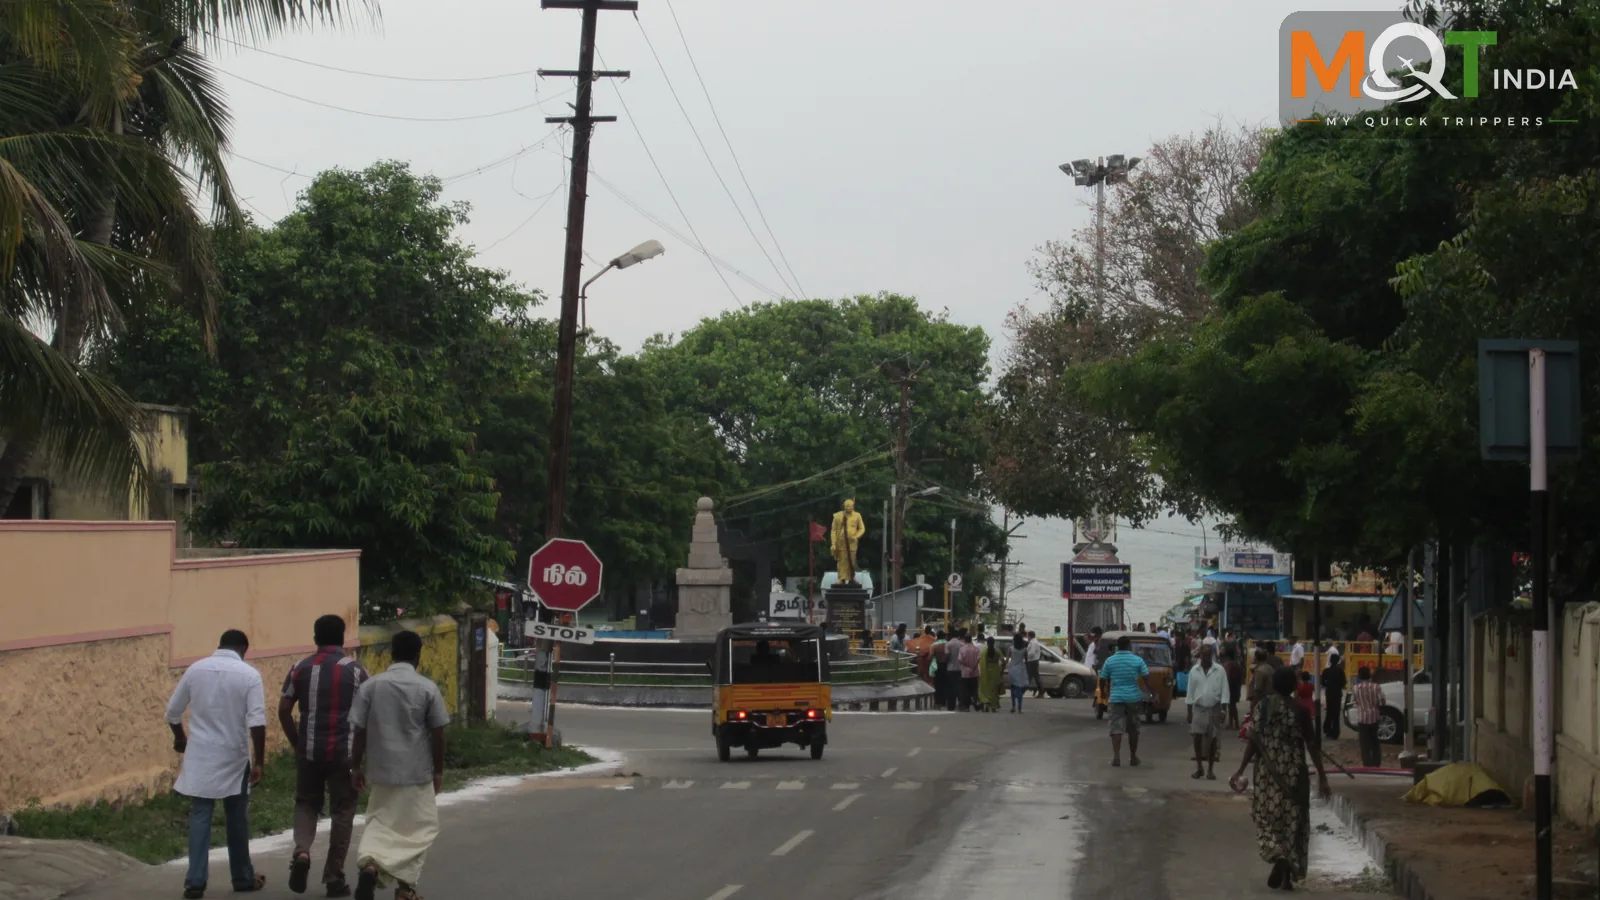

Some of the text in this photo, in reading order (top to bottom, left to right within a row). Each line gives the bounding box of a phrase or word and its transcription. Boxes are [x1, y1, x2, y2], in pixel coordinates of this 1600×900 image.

[543, 563, 587, 586] நில்
[953, 575, 958, 584] P
[982, 598, 987, 606] P
[533, 625, 587, 641] STOP
